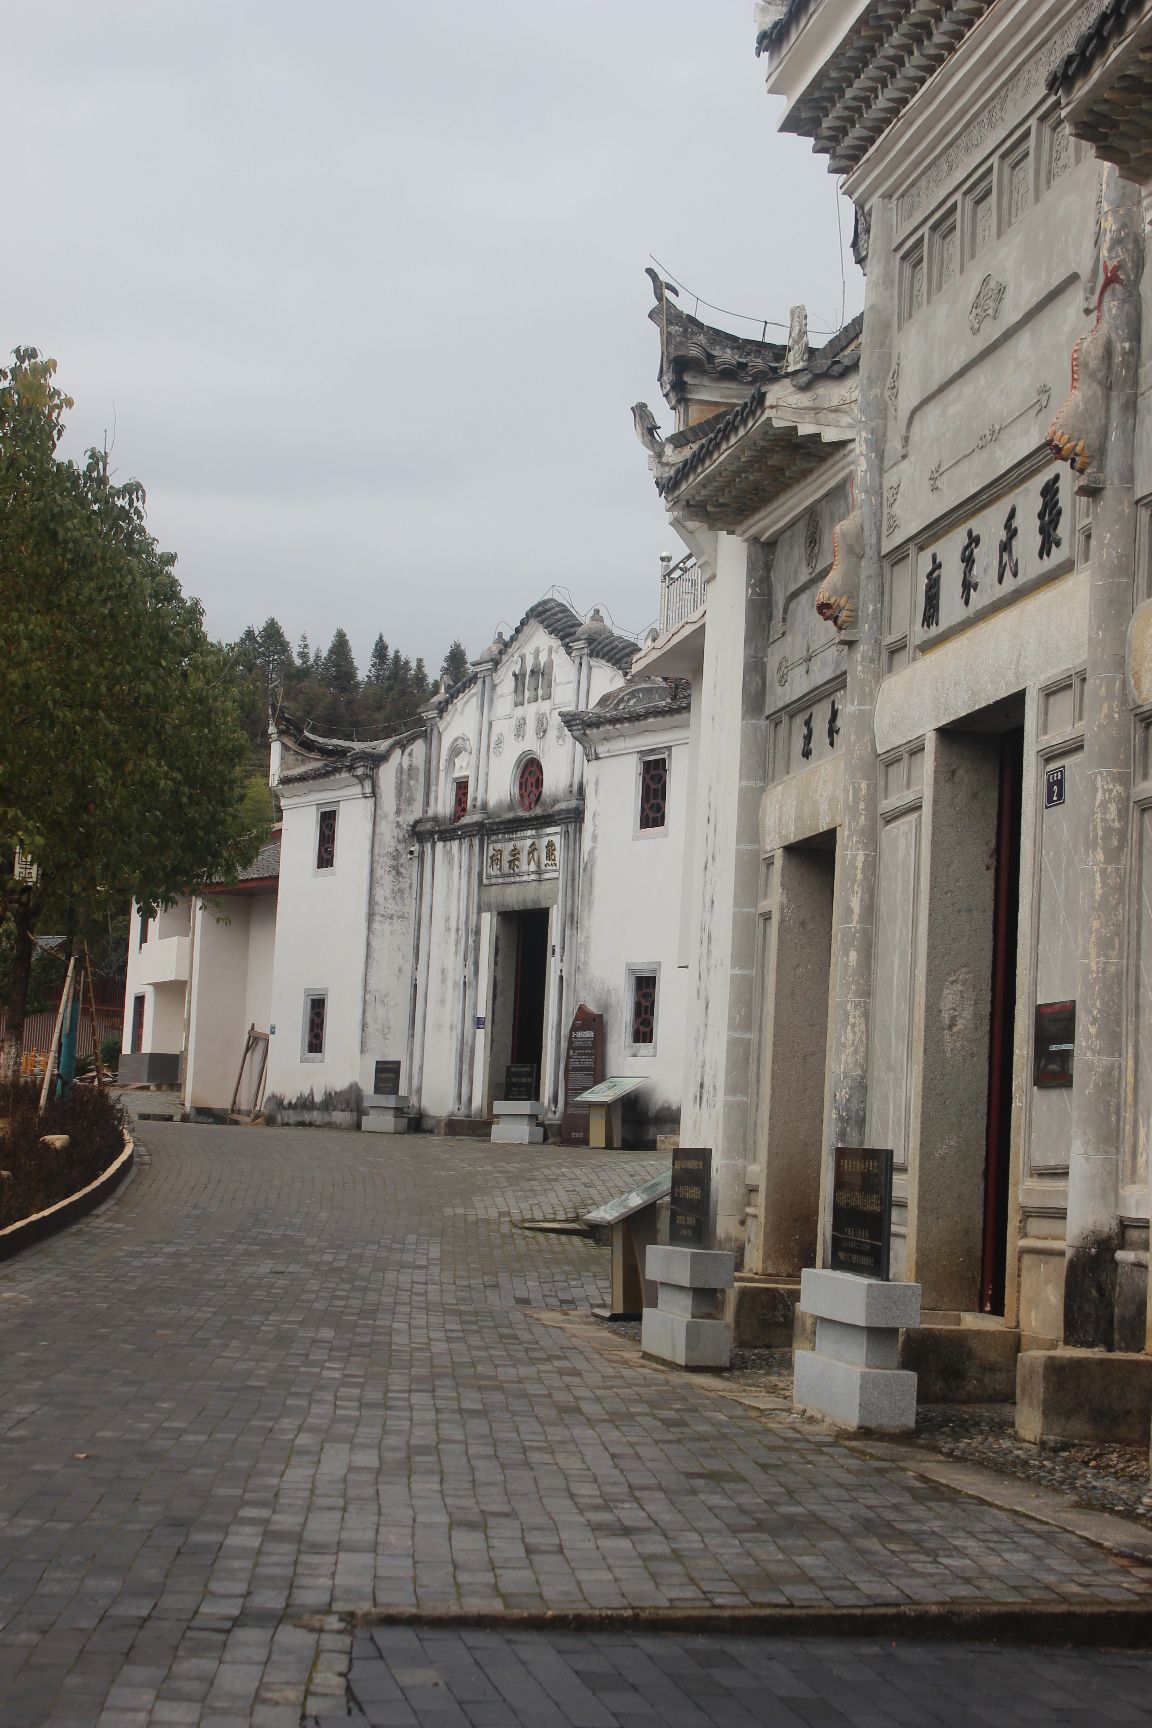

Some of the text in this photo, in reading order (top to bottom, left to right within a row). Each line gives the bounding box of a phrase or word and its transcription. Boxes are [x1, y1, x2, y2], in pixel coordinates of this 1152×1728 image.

[1052, 785, 1058, 801] 2
[489, 838, 558, 872] 熊氏宗祠
